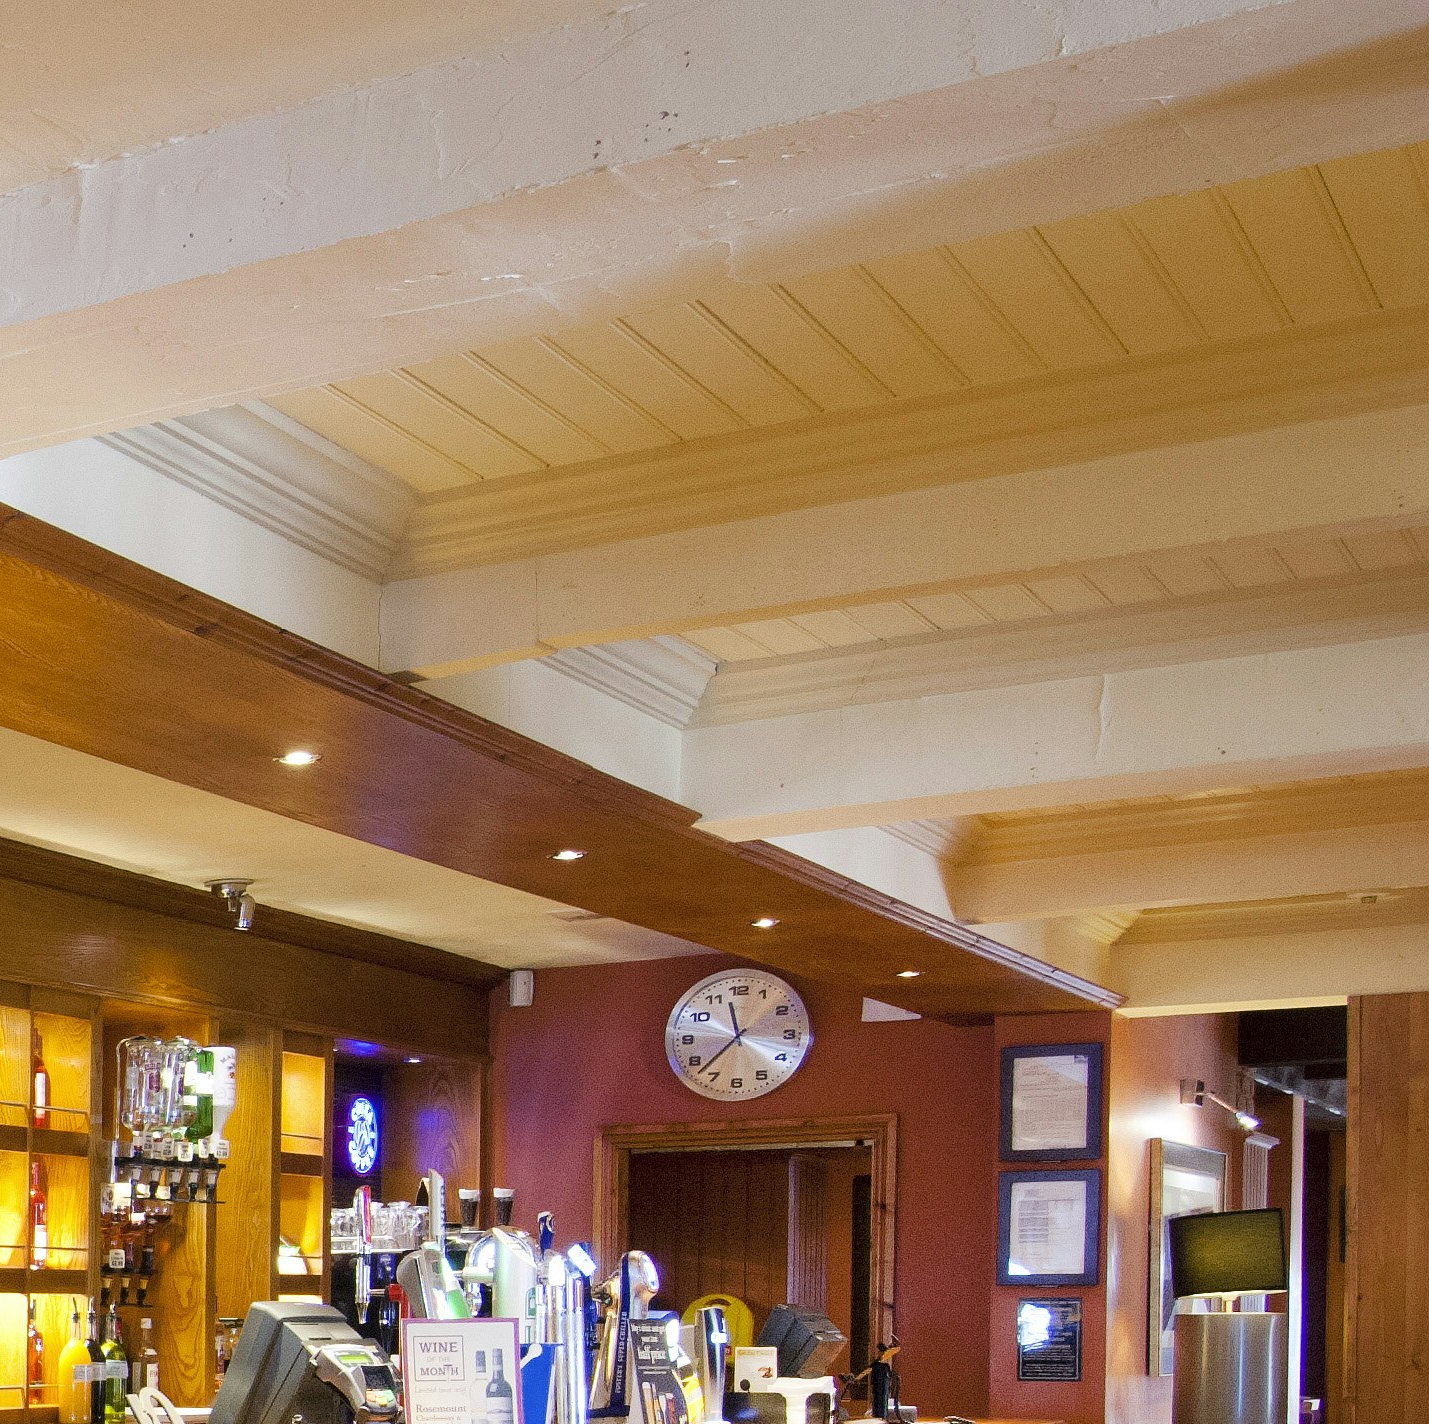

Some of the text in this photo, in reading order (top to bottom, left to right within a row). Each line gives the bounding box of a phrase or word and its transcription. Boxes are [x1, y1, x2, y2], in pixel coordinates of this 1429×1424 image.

[729, 985, 749, 995] 12
[758, 989, 767, 999] 1
[705, 994, 722, 1004] 11
[775, 1005, 789, 1015] 2
[689, 1012, 710, 1022] 10
[783, 1029, 796, 1039] 3
[681, 1035, 694, 1044] 9
[689, 1056, 701, 1066] 8
[774, 1053, 787, 1062] 4
[708, 1071, 720, 1082] 7
[755, 1070, 768, 1080] 5
[730, 1078, 743, 1088] 6
[419, 1341, 458, 1353] WINE
[420, 1364, 459, 1376] MONTH
[416, 1404, 467, 1413] Rosemount
